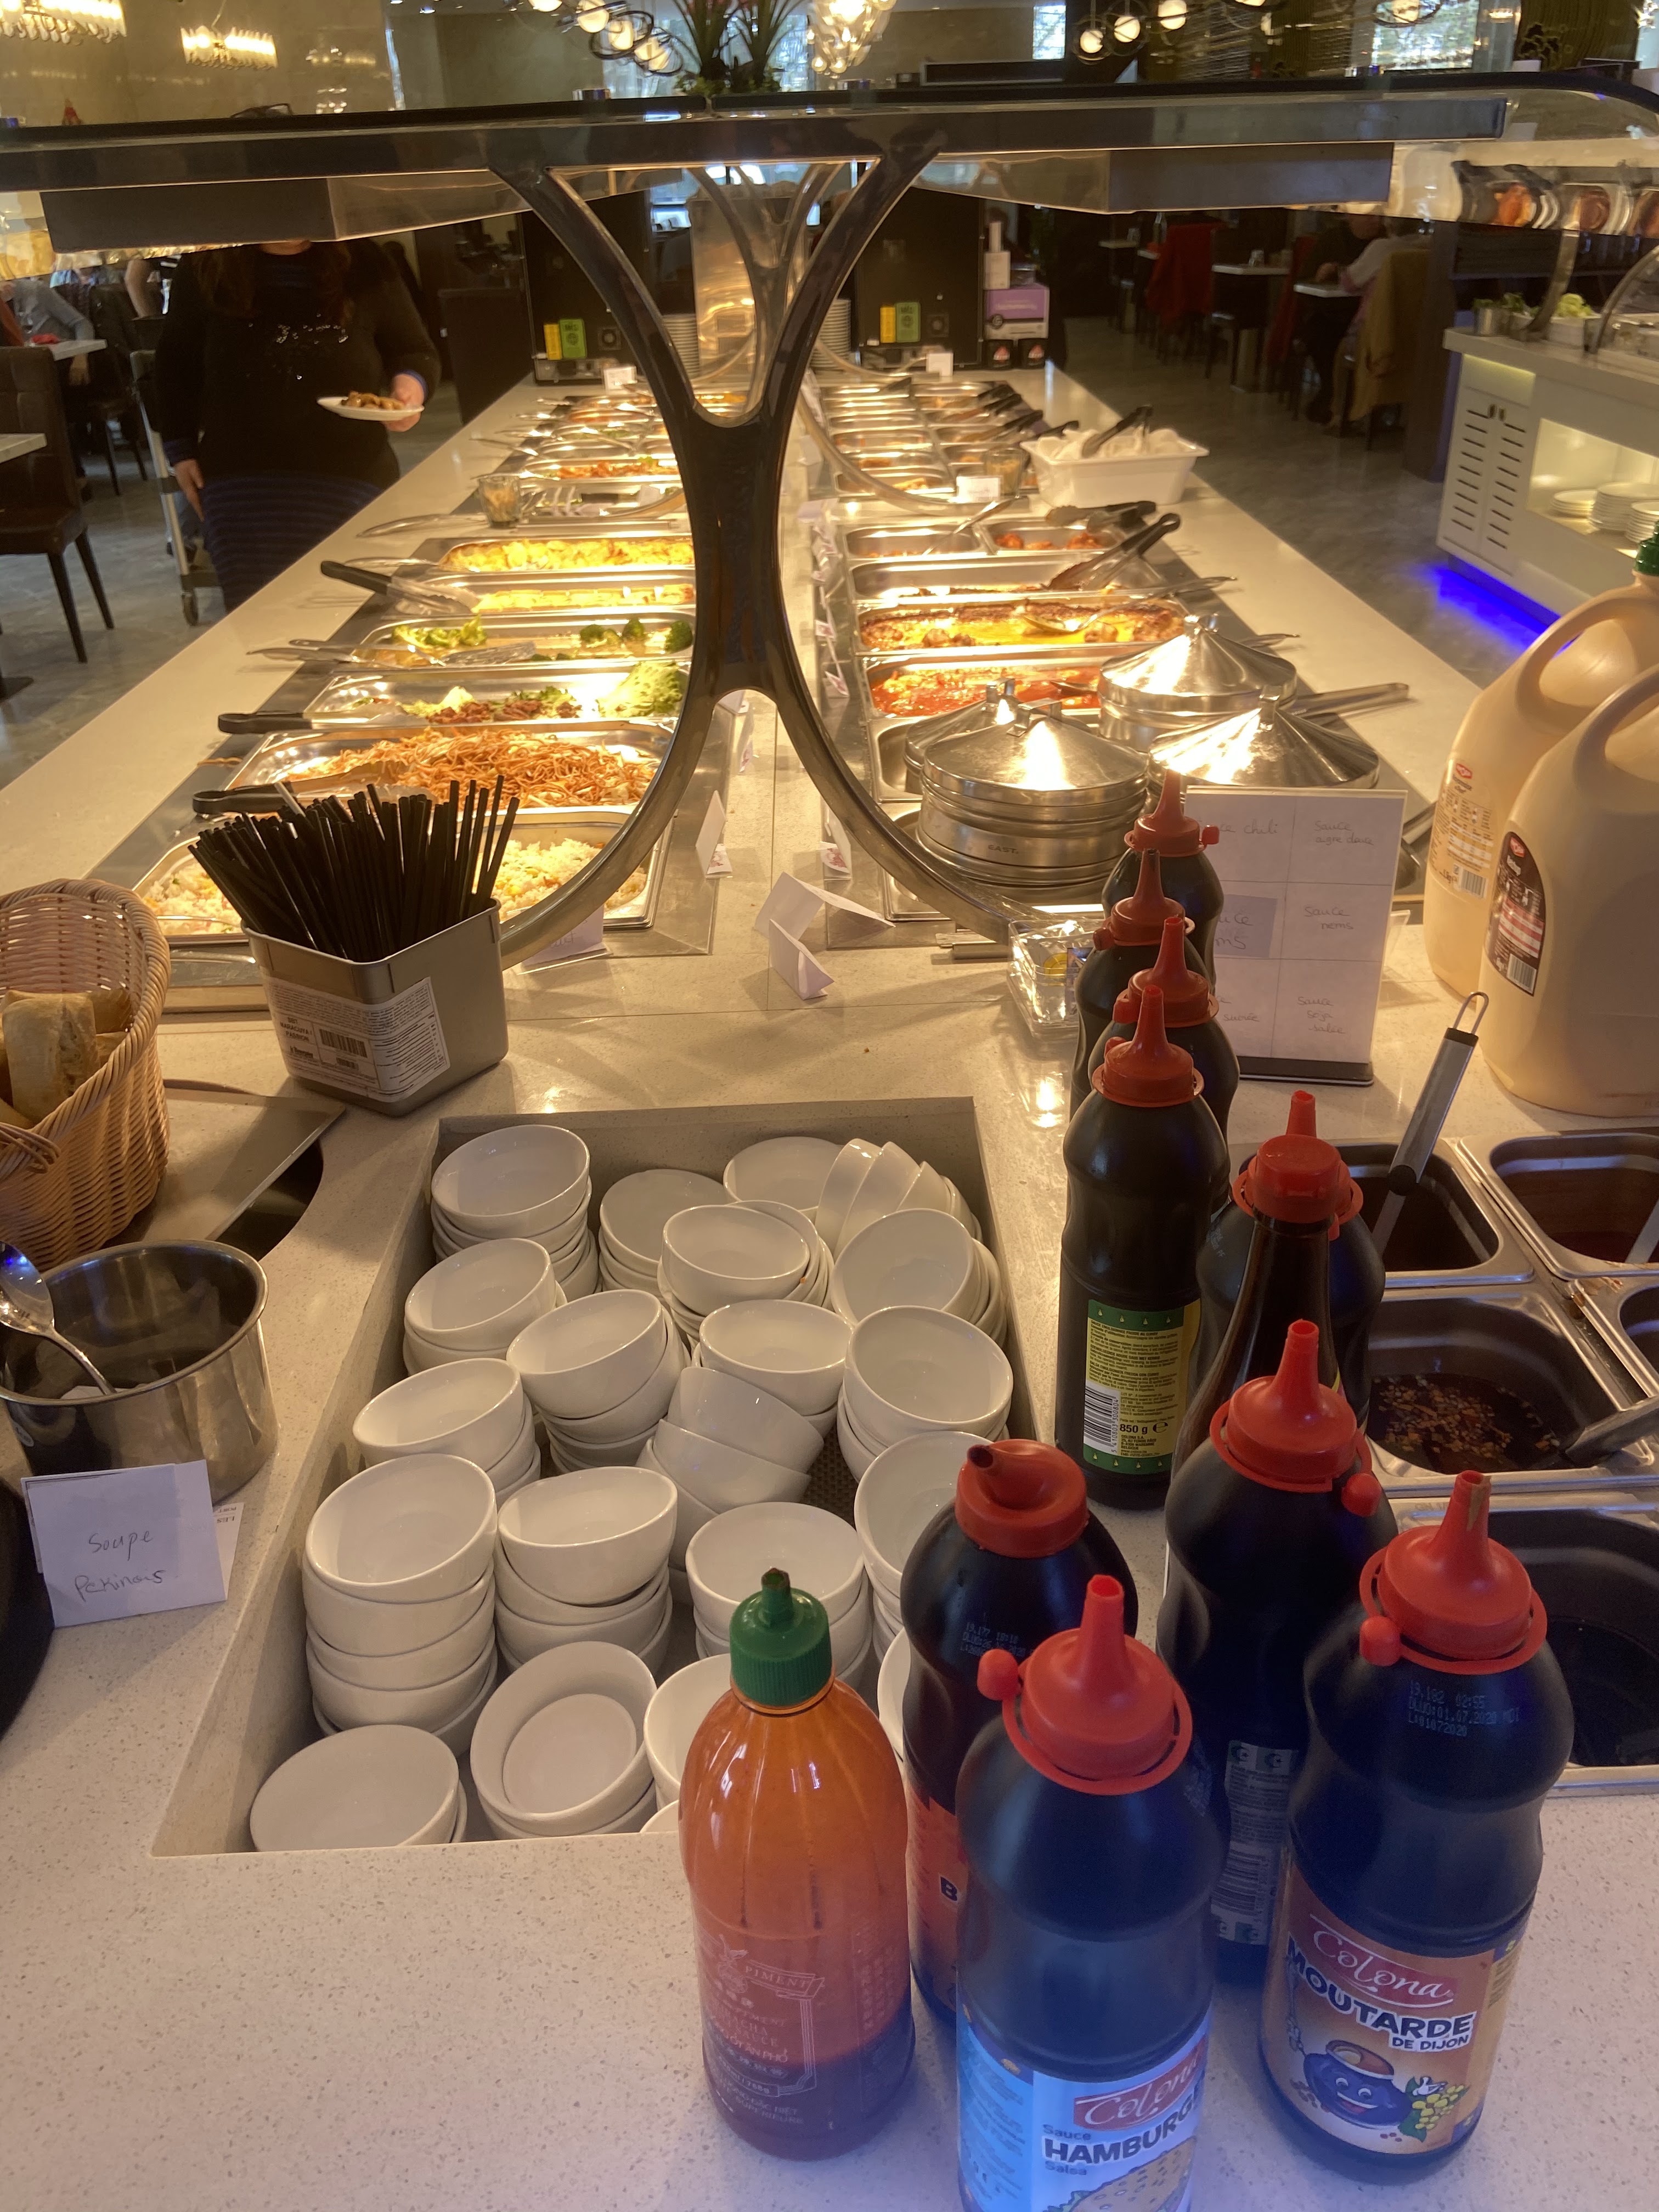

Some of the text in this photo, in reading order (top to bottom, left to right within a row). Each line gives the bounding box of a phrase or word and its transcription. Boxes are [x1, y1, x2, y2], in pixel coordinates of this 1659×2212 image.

[1304, 906, 1351, 917] Sauce
[1297, 996, 1335, 1007] Sauce
[1120, 1424, 1138, 1434] 850
[88, 1530, 154, 1562] Soupe
[1313, 1930, 1451, 2000] Colona
[745, 1966, 809, 1988] PIMENT
[1287, 1935, 1476, 2039] MOUTARDE
[1392, 2033, 1469, 2051] DE DIJON
[1085, 2056, 1197, 2125] Colona
[1043, 2124, 1092, 2141] Sauce
[1045, 2161, 1087, 2176] Salsa
